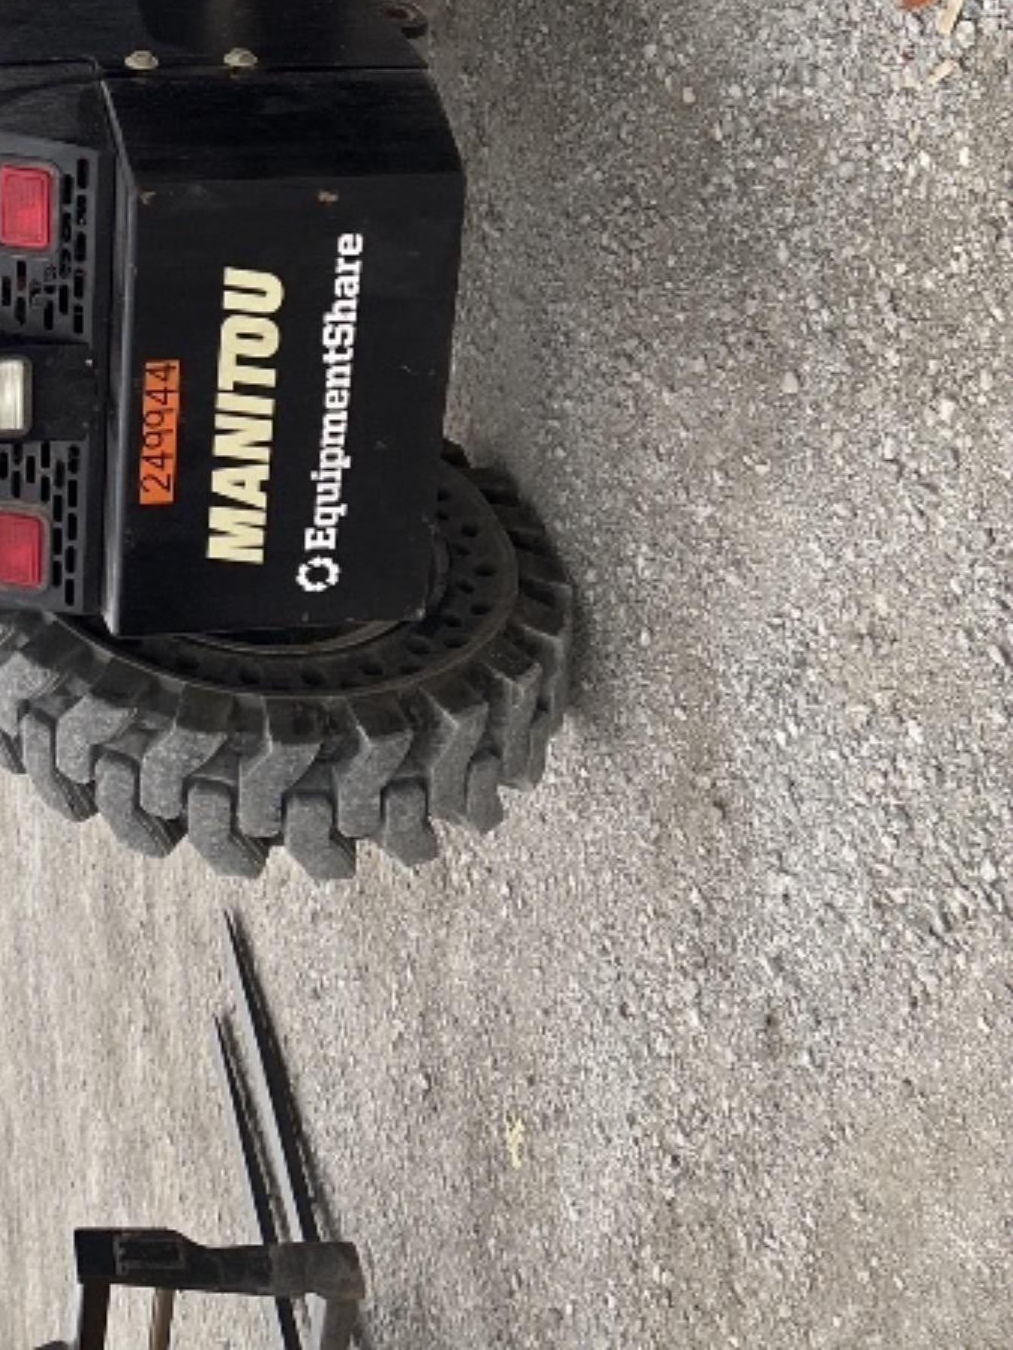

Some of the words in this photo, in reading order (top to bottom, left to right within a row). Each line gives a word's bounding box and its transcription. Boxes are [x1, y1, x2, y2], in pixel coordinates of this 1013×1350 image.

[141, 359, 178, 494] 249944
[205, 266, 285, 565] MANITOU
[303, 233, 364, 552] EquipmentShare
